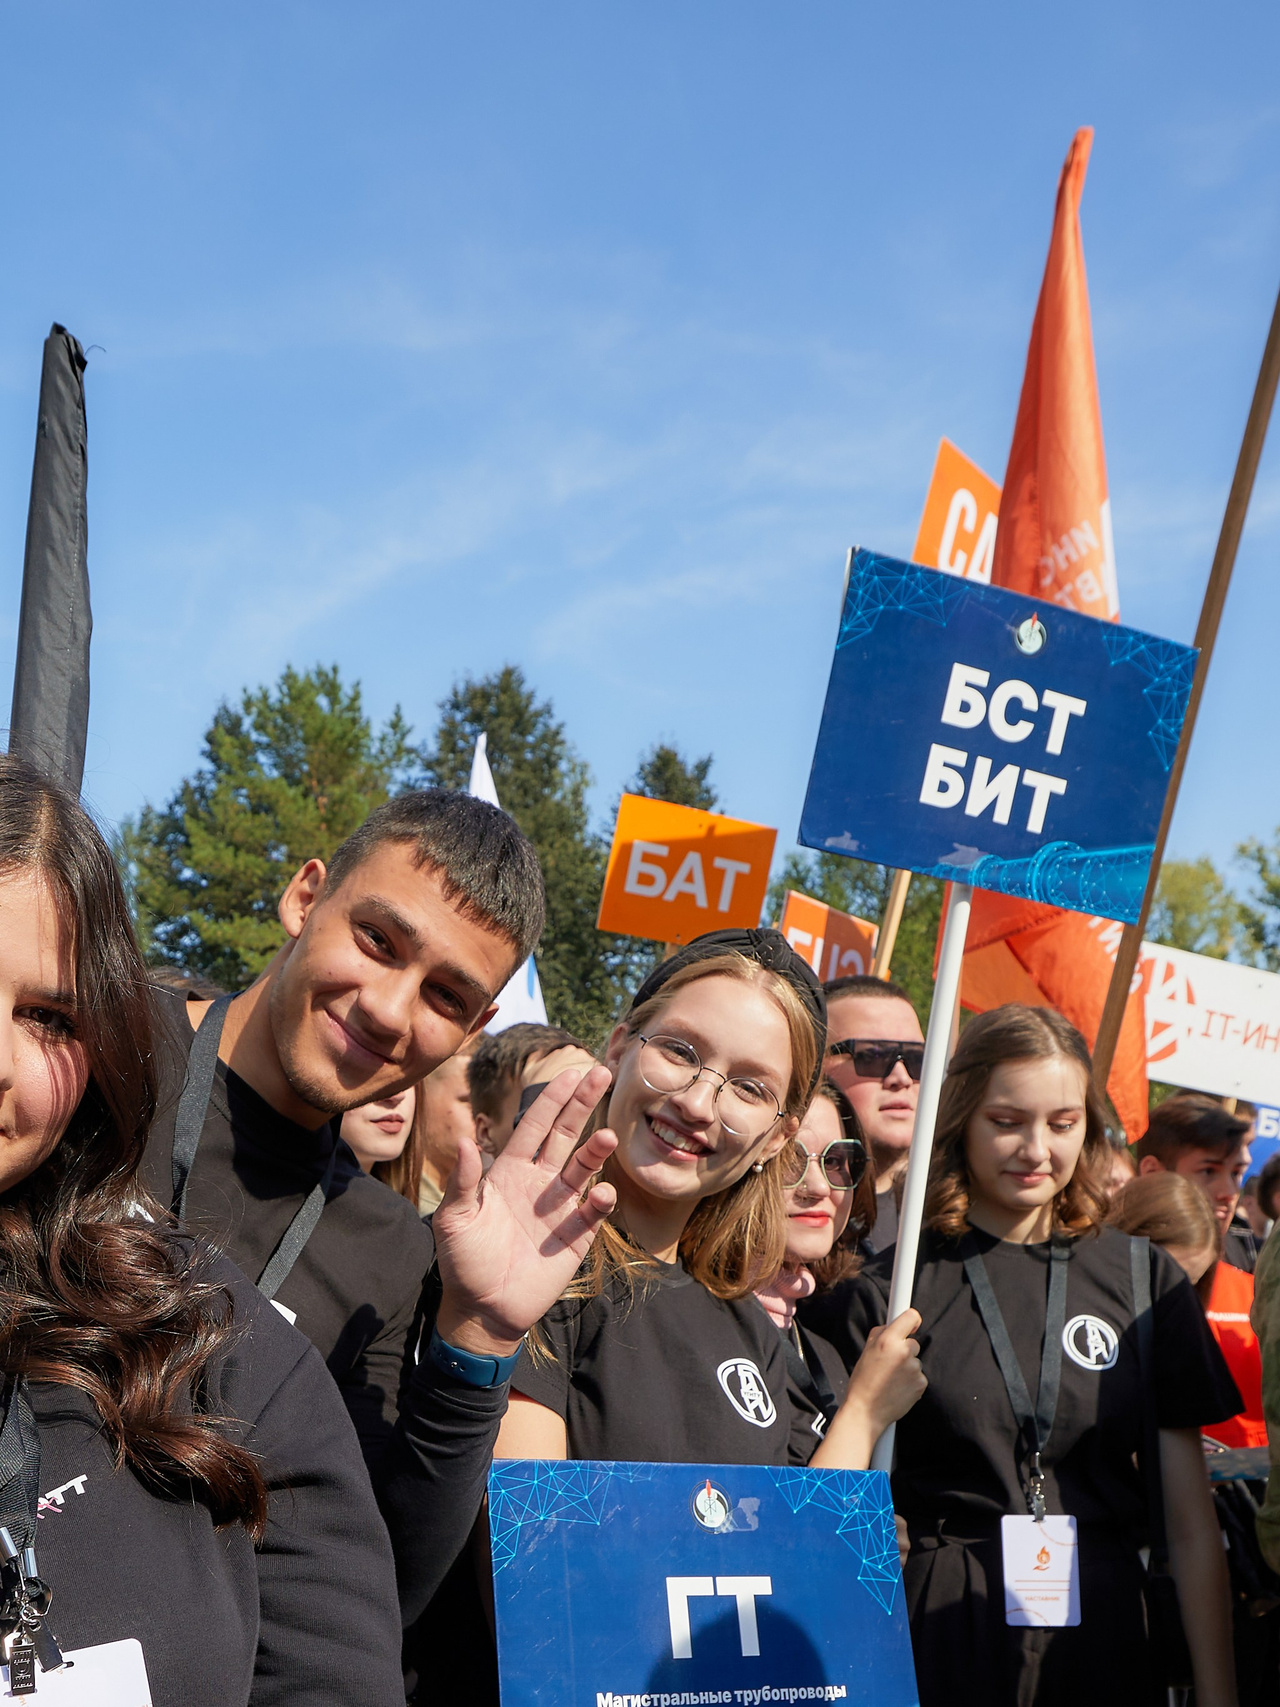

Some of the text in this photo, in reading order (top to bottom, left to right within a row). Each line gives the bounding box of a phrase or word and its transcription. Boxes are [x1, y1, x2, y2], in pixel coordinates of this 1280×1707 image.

[937, 487, 999, 585] СА
[940, 662, 1087, 755] БСТ
[918, 743, 1067, 835] БИТ
[623, 839, 751, 913] БАТ
[1200, 1009, 1280, 1053] IT-ИН
[1257, 1107, 1280, 1140] Б
[665, 1576, 773, 1659] ГТ
[596, 1684, 847, 1707] Магистральные трубопроводы
